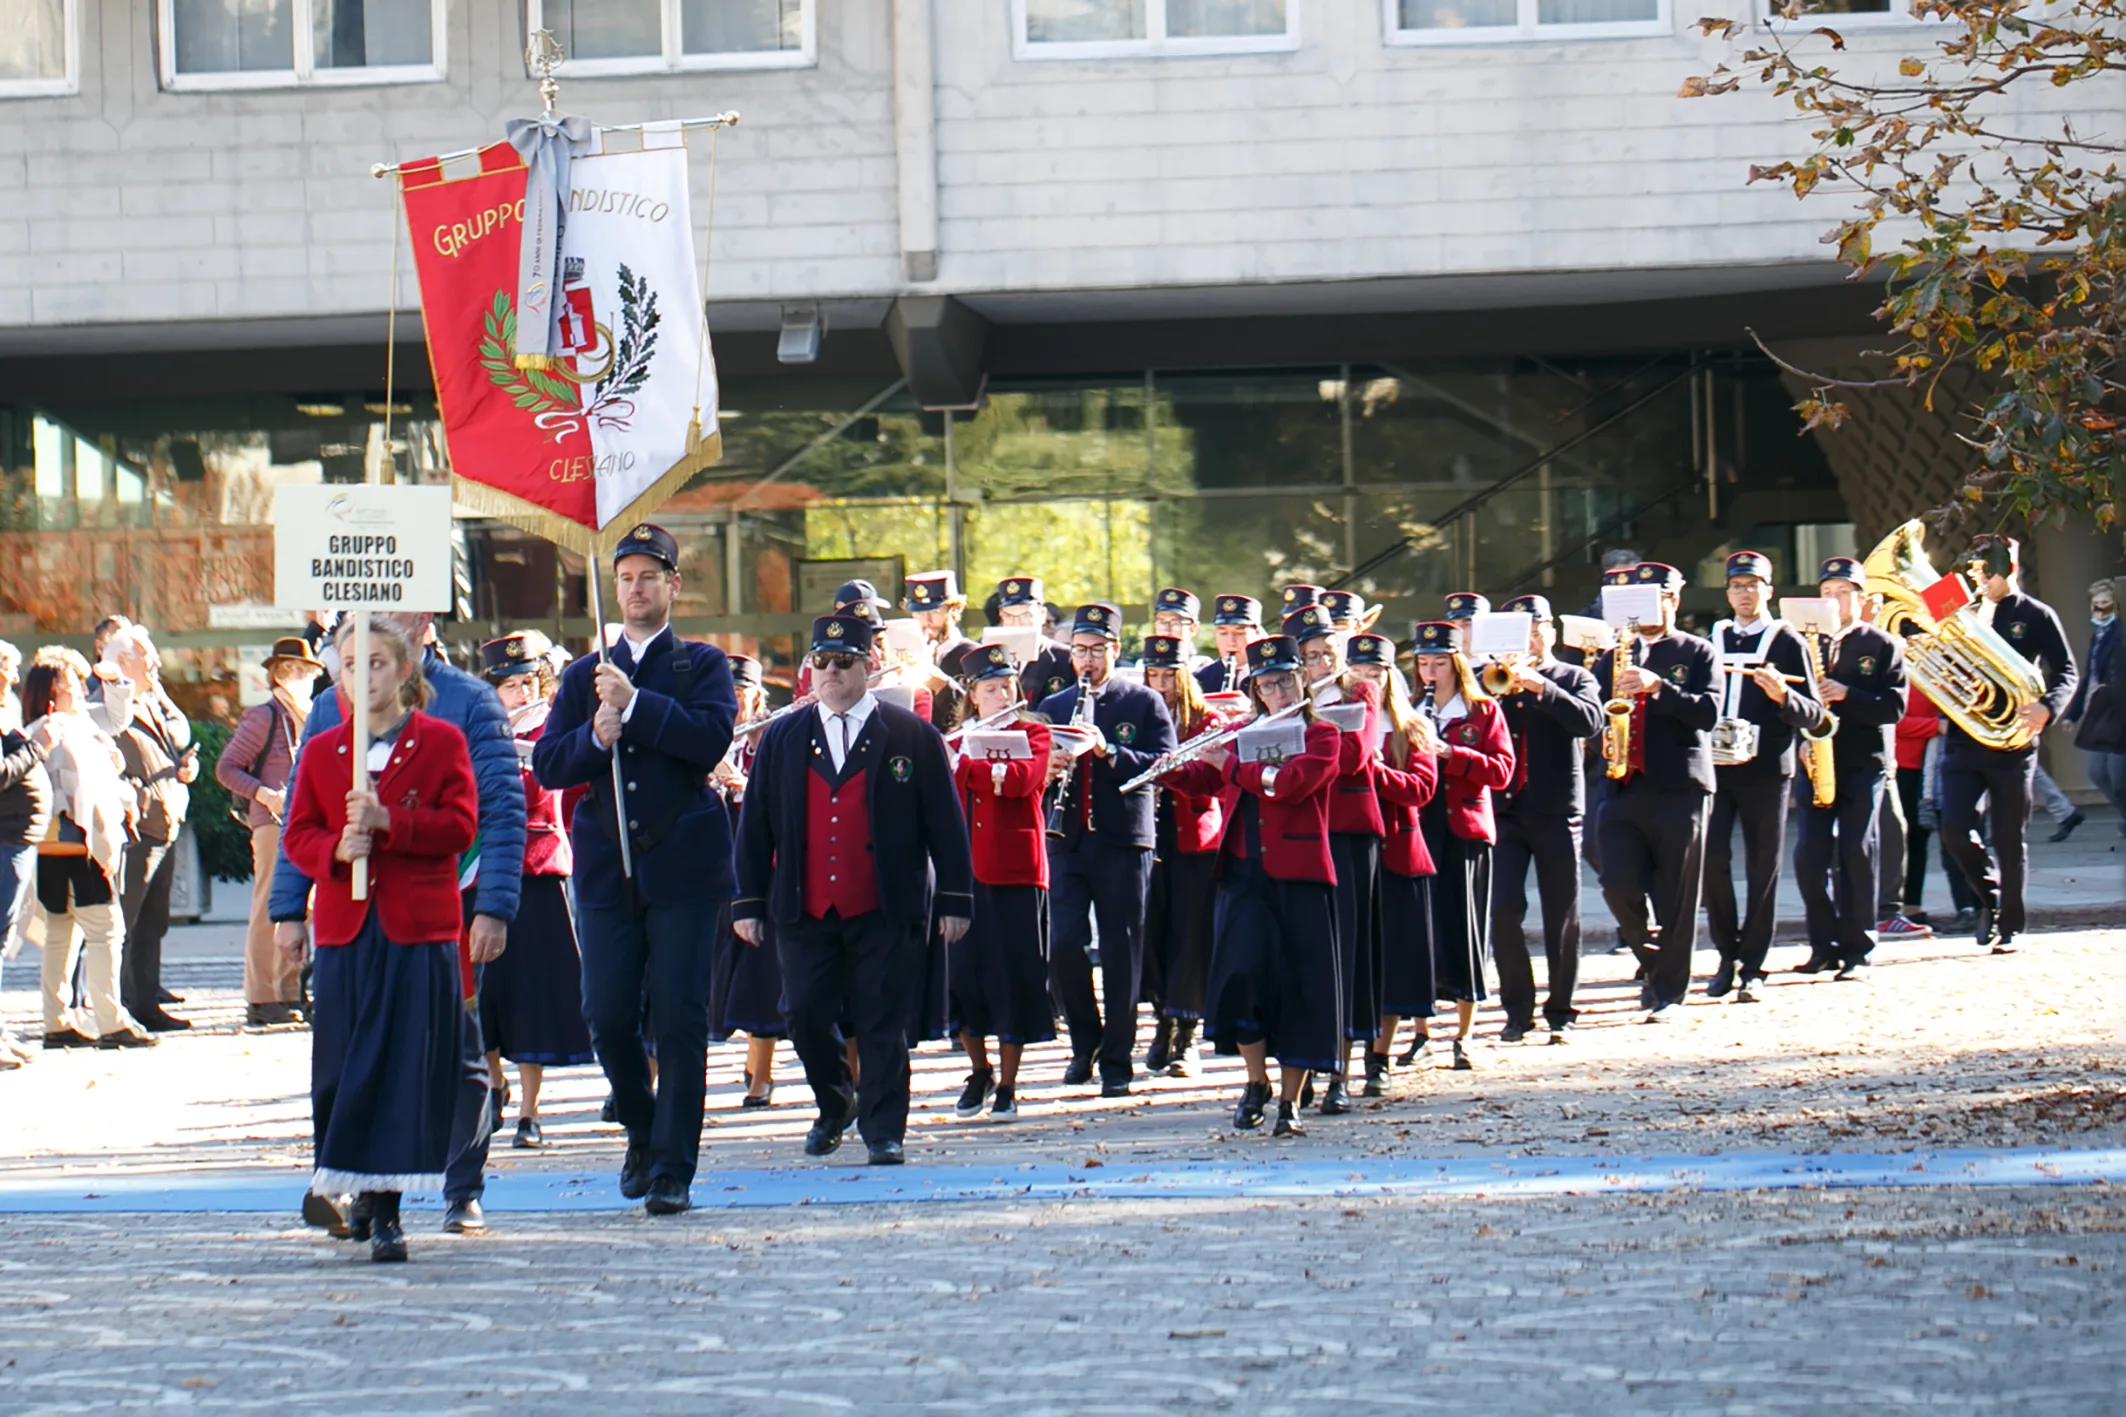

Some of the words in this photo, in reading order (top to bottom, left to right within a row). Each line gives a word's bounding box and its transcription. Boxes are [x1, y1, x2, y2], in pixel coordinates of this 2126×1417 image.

[568, 188, 669, 222] NDISTICO
[329, 535, 397, 554] GRUPPO
[311, 559, 414, 578] BANDISTICO
[322, 582, 403, 601] CLESIANO
